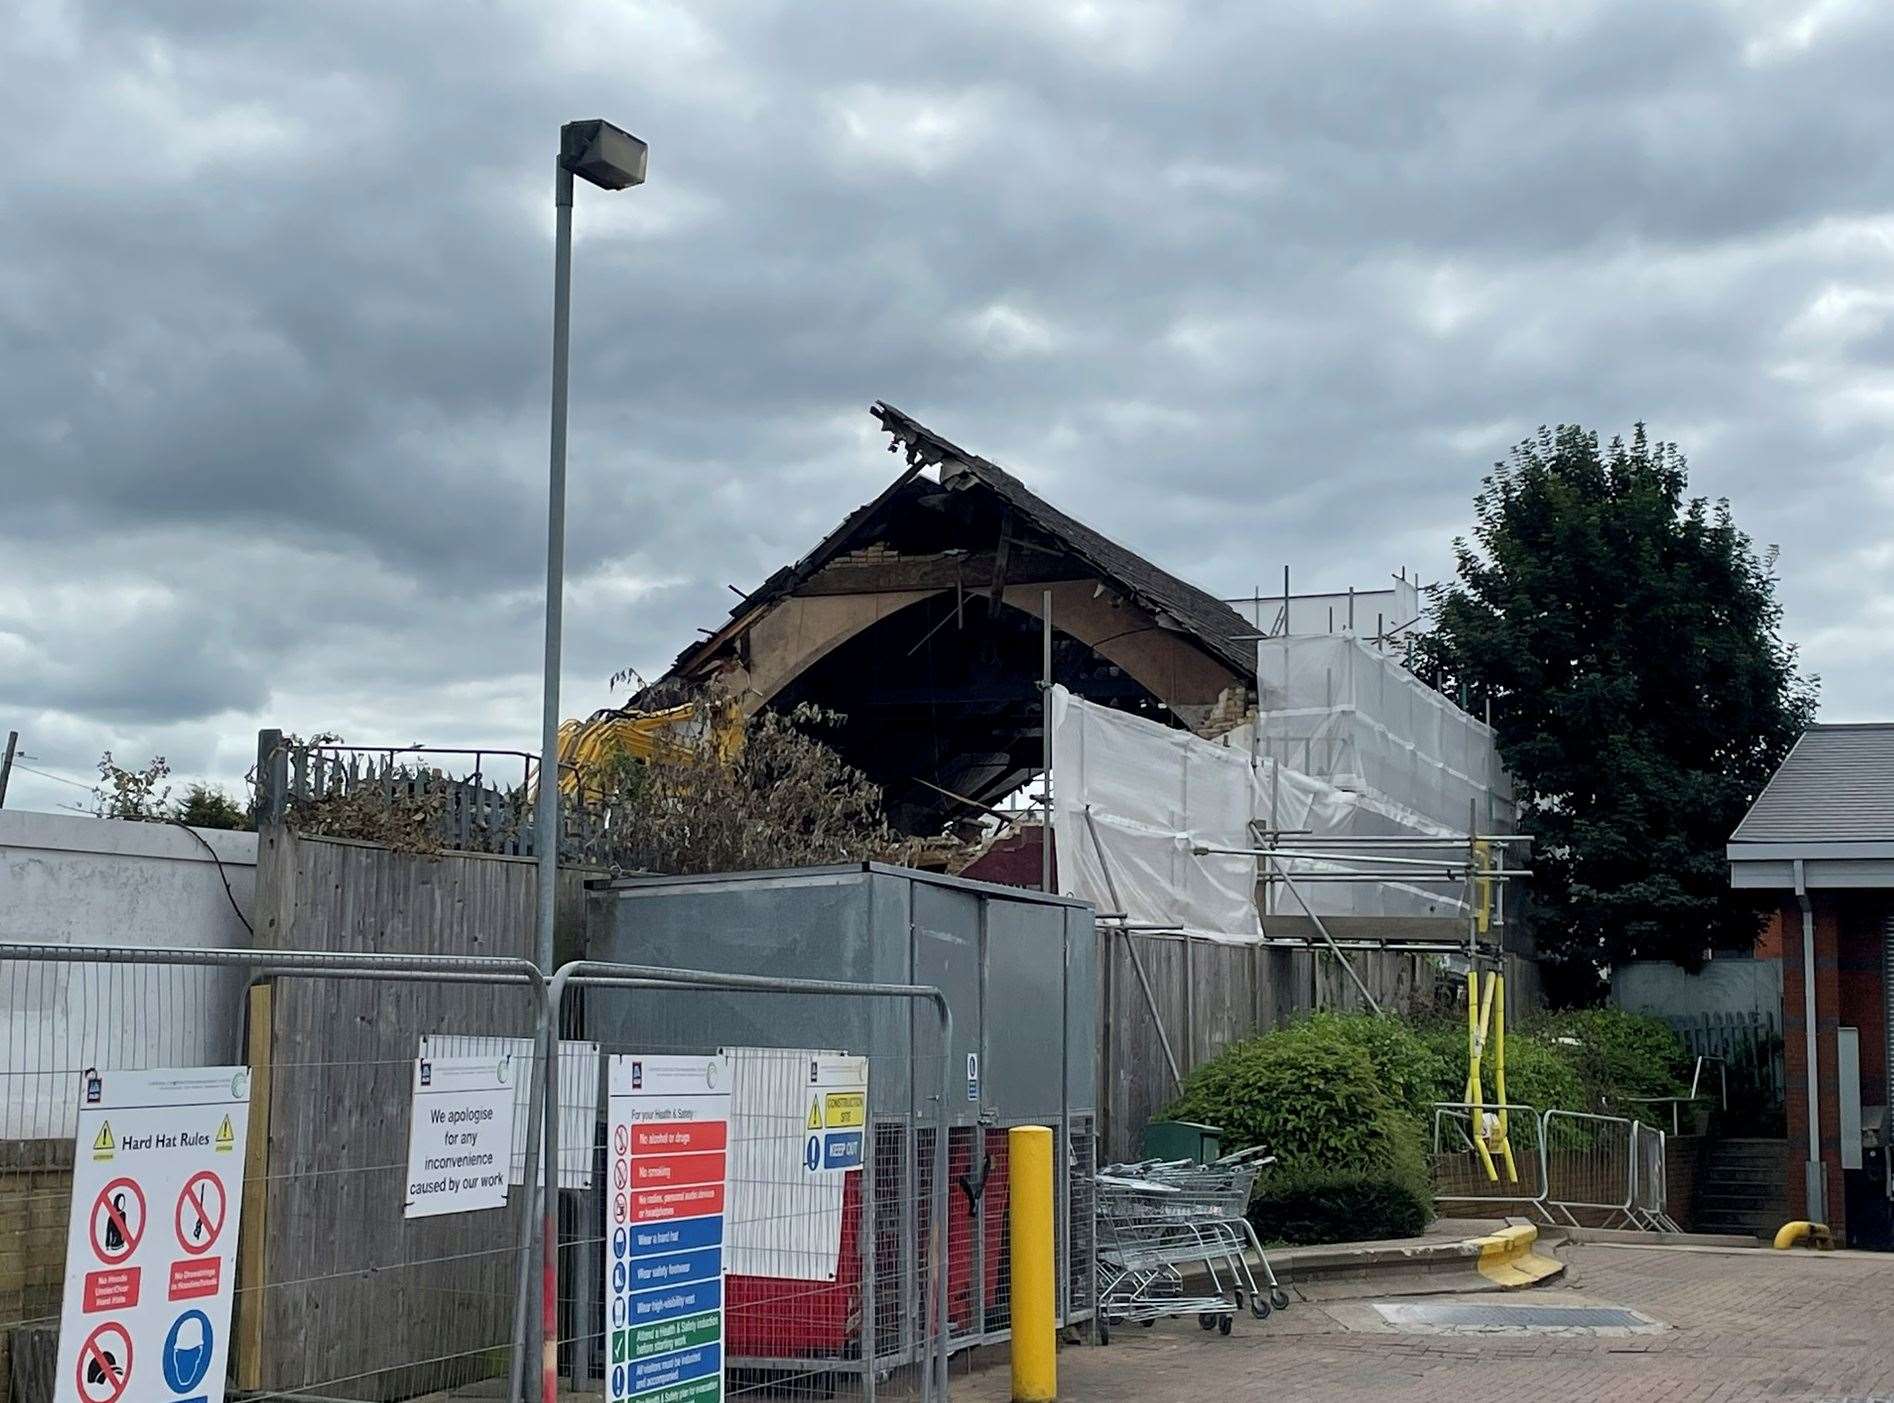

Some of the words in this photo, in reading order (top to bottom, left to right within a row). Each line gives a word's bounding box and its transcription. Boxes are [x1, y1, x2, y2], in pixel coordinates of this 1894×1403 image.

[431, 1109, 445, 1124] We
[448, 1107, 493, 1124] apologise
[631, 1109, 640, 1119] For
[642, 1111, 654, 1121] your
[122, 1135, 152, 1150] Hard
[156, 1134, 177, 1148] Hat
[181, 1132, 209, 1147] Rules
[444, 1131, 458, 1145] for
[460, 1132, 478, 1146] any
[639, 1133, 648, 1144] No
[649, 1133, 668, 1144] alcohol
[675, 1132, 690, 1145] drugs
[425, 1151, 493, 1170] inconvenience
[639, 1167, 648, 1177] No
[648, 1166, 671, 1178] smoking
[410, 1176, 446, 1195] caused
[448, 1178, 461, 1193] by
[463, 1177, 478, 1189] our
[481, 1173, 504, 1186] work
[637, 1234, 652, 1245] Wear
[657, 1232, 670, 1243] hard
[670, 1231, 679, 1242] hat
[637, 1268, 652, 1279] Wear
[652, 1265, 668, 1278] safety
[637, 1302, 651, 1314] Wear
